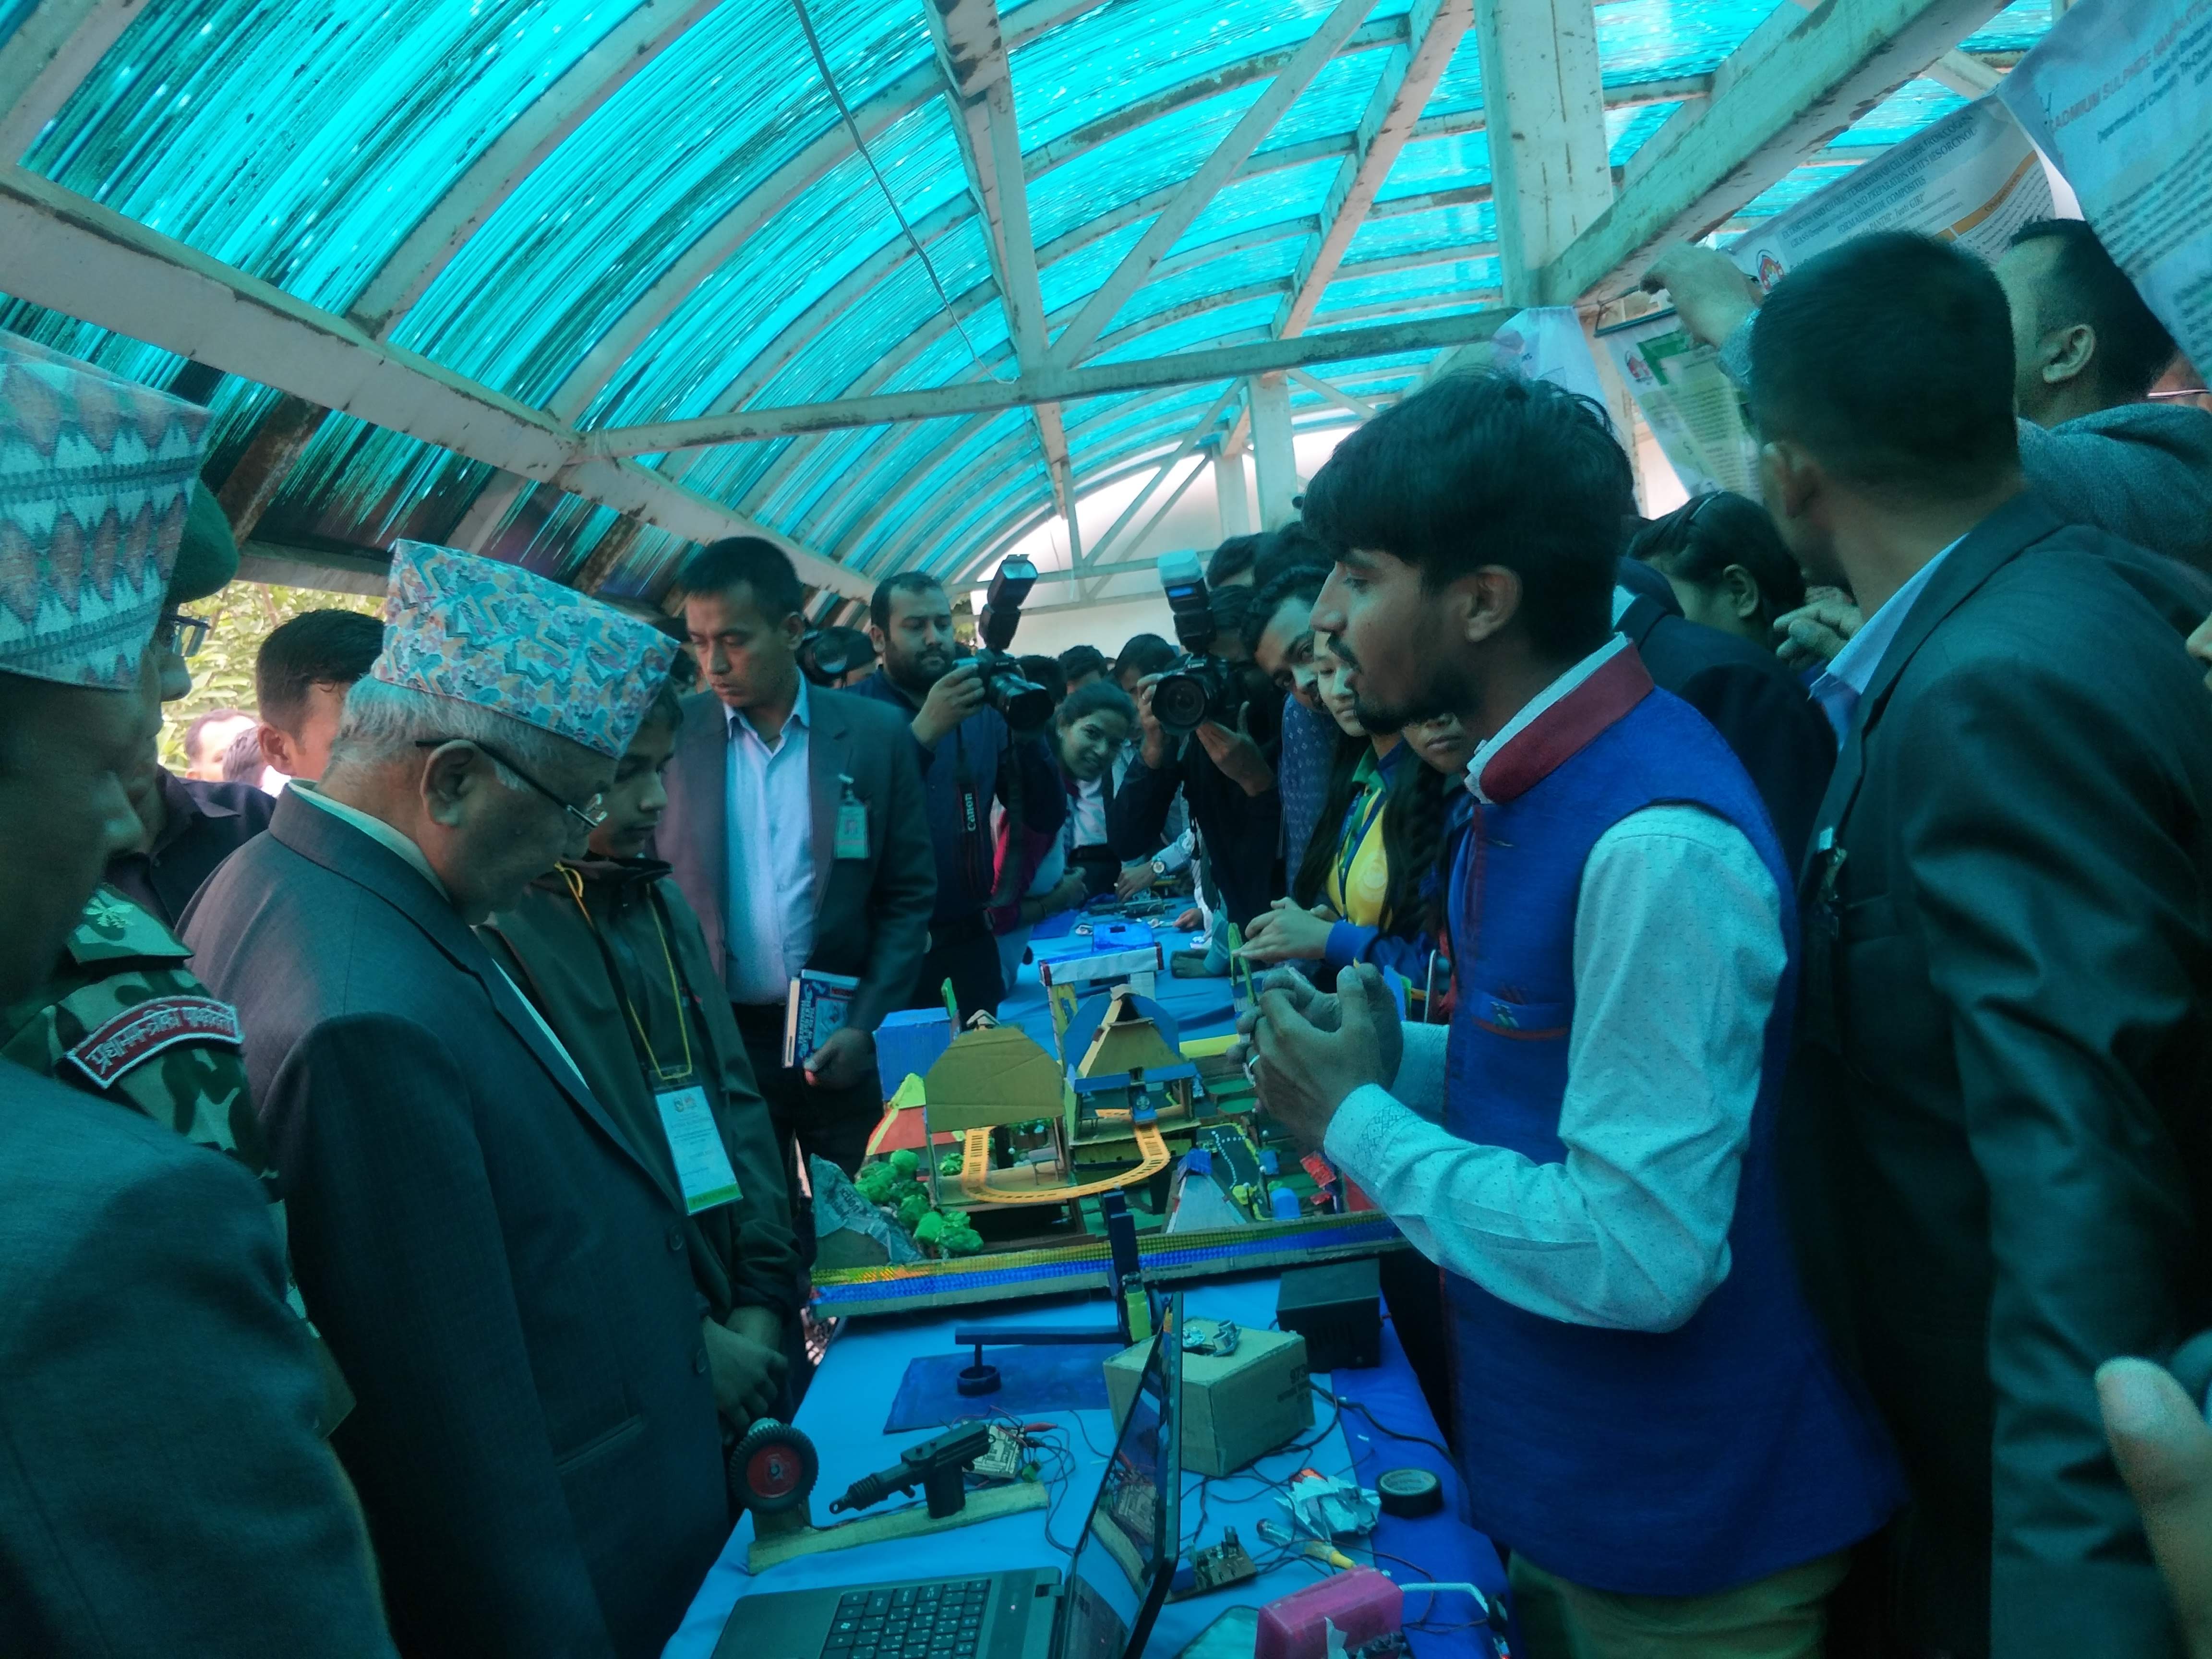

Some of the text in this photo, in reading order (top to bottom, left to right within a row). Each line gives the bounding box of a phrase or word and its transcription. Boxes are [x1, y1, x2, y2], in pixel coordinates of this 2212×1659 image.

[1853, 195, 1869, 209] AND
[1906, 163, 1921, 176] OF
[965, 793, 976, 831] Canon
